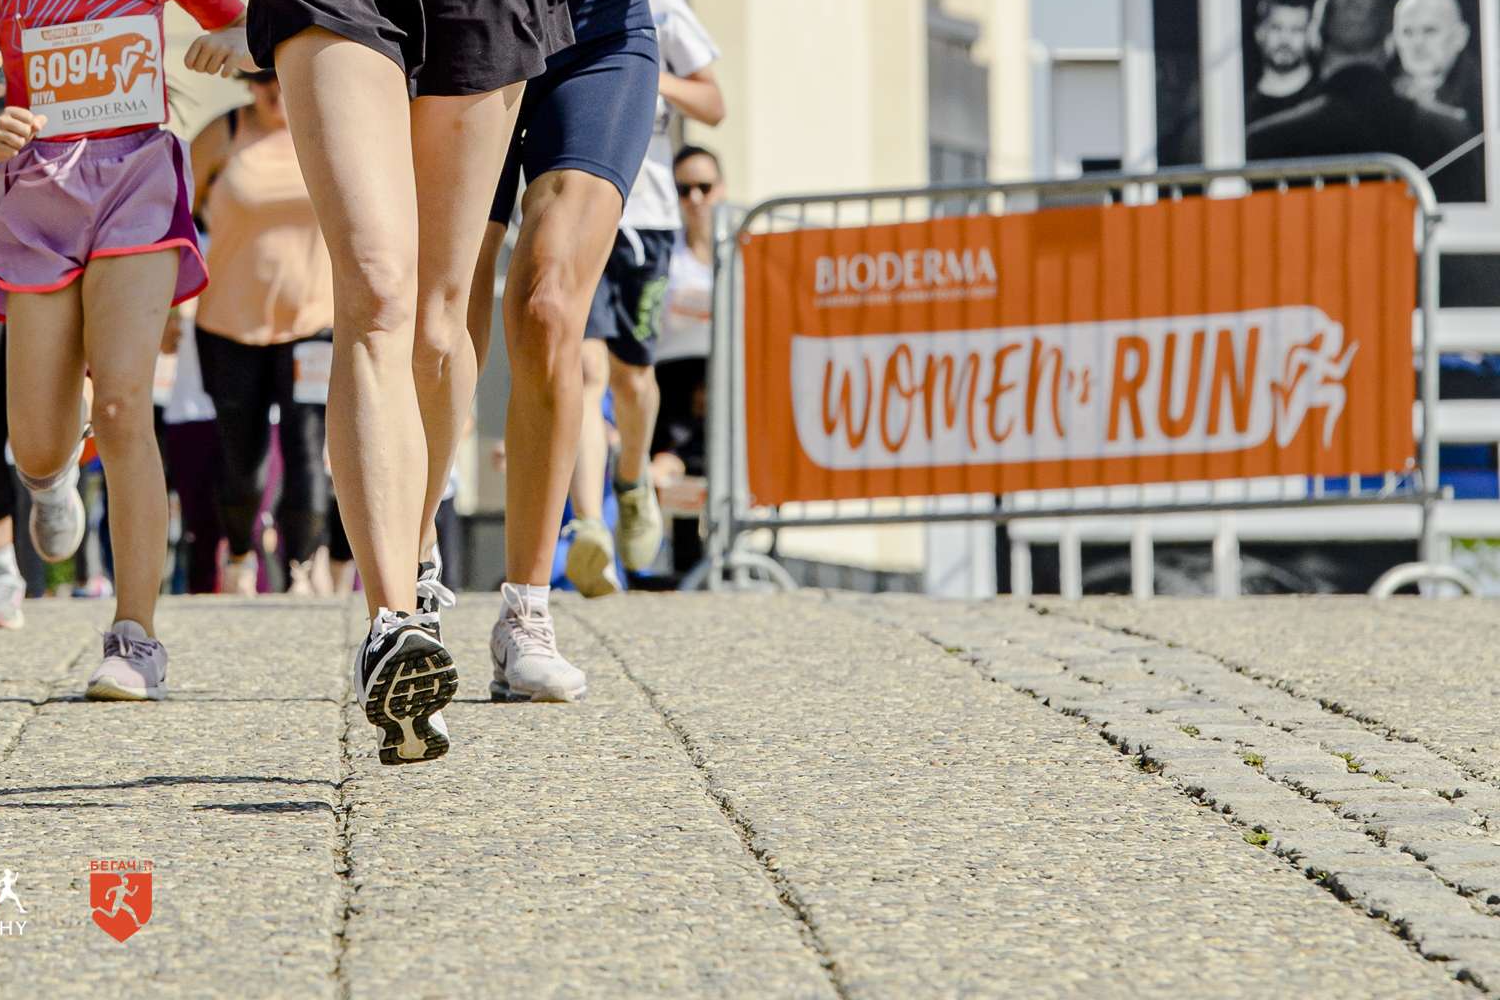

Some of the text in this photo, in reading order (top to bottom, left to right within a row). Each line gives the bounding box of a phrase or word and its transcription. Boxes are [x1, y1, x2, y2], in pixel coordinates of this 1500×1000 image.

[28, 47, 108, 90] 6094
[62, 99, 148, 120] BIODERMA
[814, 246, 998, 294] BIODERMA
[1106, 327, 1260, 442] RUN
